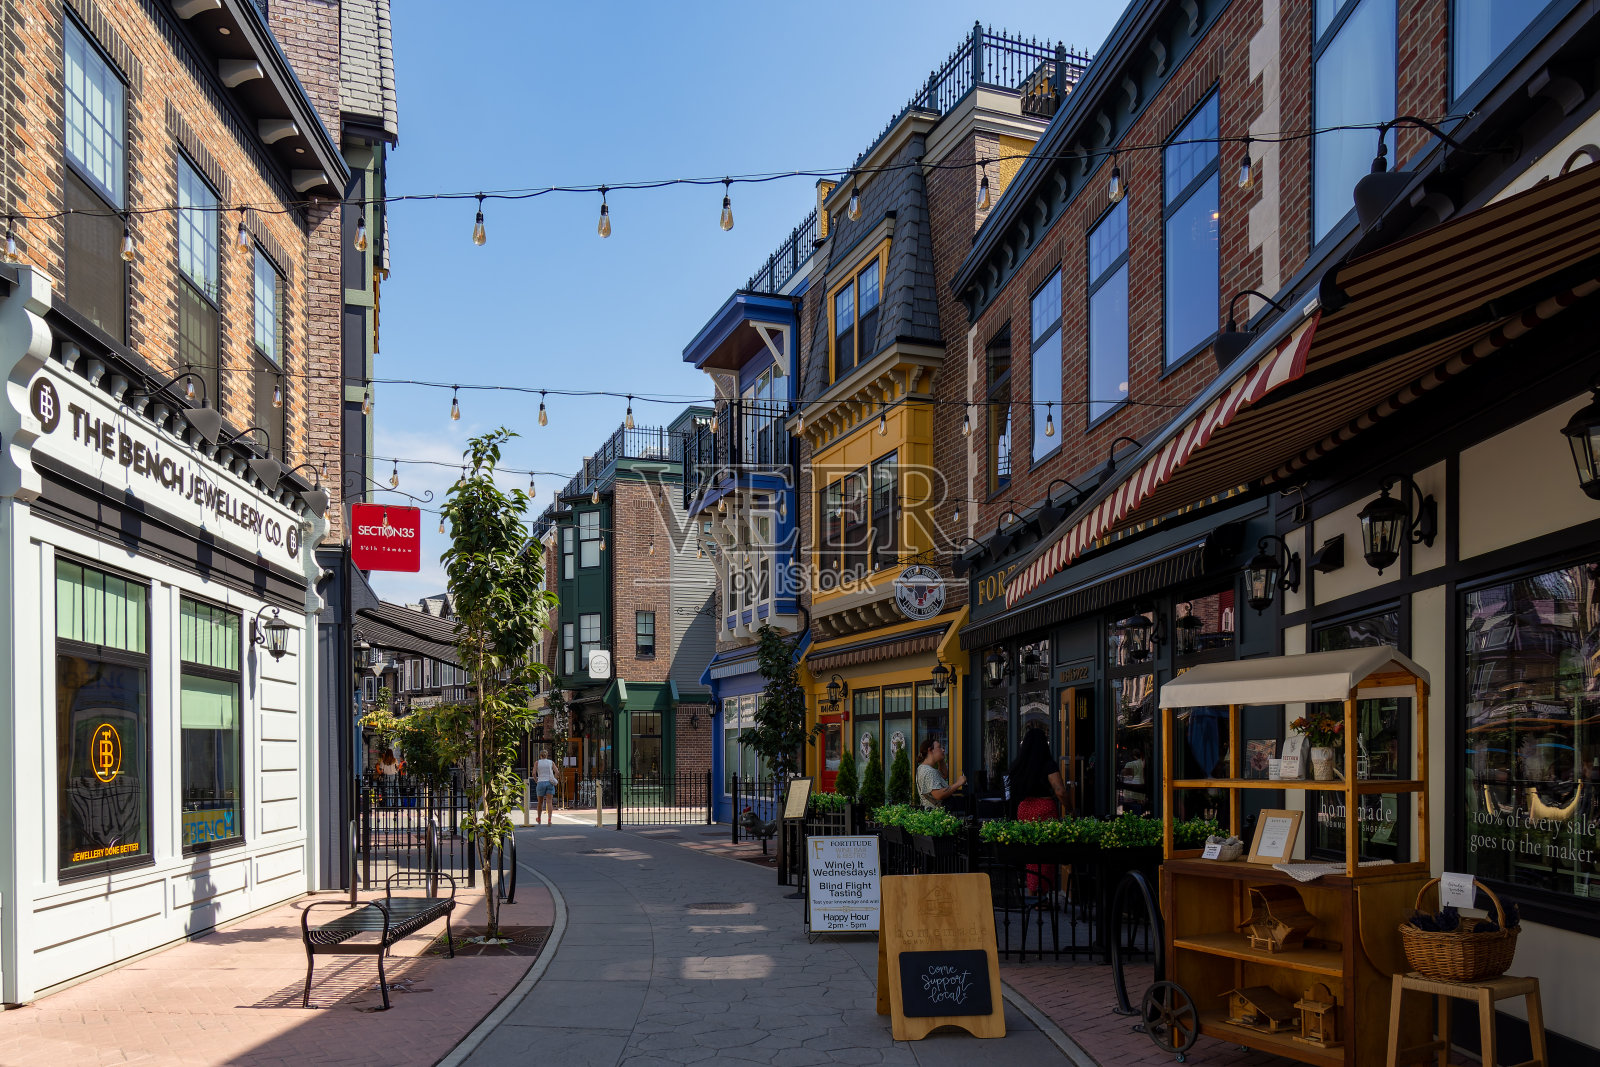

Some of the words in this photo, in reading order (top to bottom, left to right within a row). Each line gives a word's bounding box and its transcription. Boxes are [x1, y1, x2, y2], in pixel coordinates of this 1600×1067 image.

[68, 402, 116, 459] THE
[118, 432, 184, 497] BENCH
[185, 472, 265, 538] JEWELLERY
[265, 517, 285, 549] CO.
[358, 525, 415, 538] SECTION35
[1321, 795, 1392, 822] hommade
[1473, 809, 1503, 826] 100%
[1506, 807, 1523, 828] of
[1524, 817, 1562, 839] every
[1567, 813, 1596, 837] sale
[72, 848, 104, 862] JEWELLERY
[105, 845, 120, 857] DONE
[120, 842, 139, 853] BETTER
[1470, 834, 1497, 853] goes
[1501, 836, 1515, 852] to
[1519, 833, 1542, 855] the
[1546, 839, 1598, 864] maker.
[824, 861, 855, 870] Win(e)
[857, 861, 864, 869] It
[812, 868, 877, 877] Wednesdays!
[819, 882, 843, 890] Blind
[845, 882, 872, 891] Flight
[829, 889, 863, 898] Tasting
[823, 913, 848, 922] Happy
[850, 913, 870, 921] Hour
[827, 922, 844, 930] 2pm
[850, 922, 867, 930] 5pm
